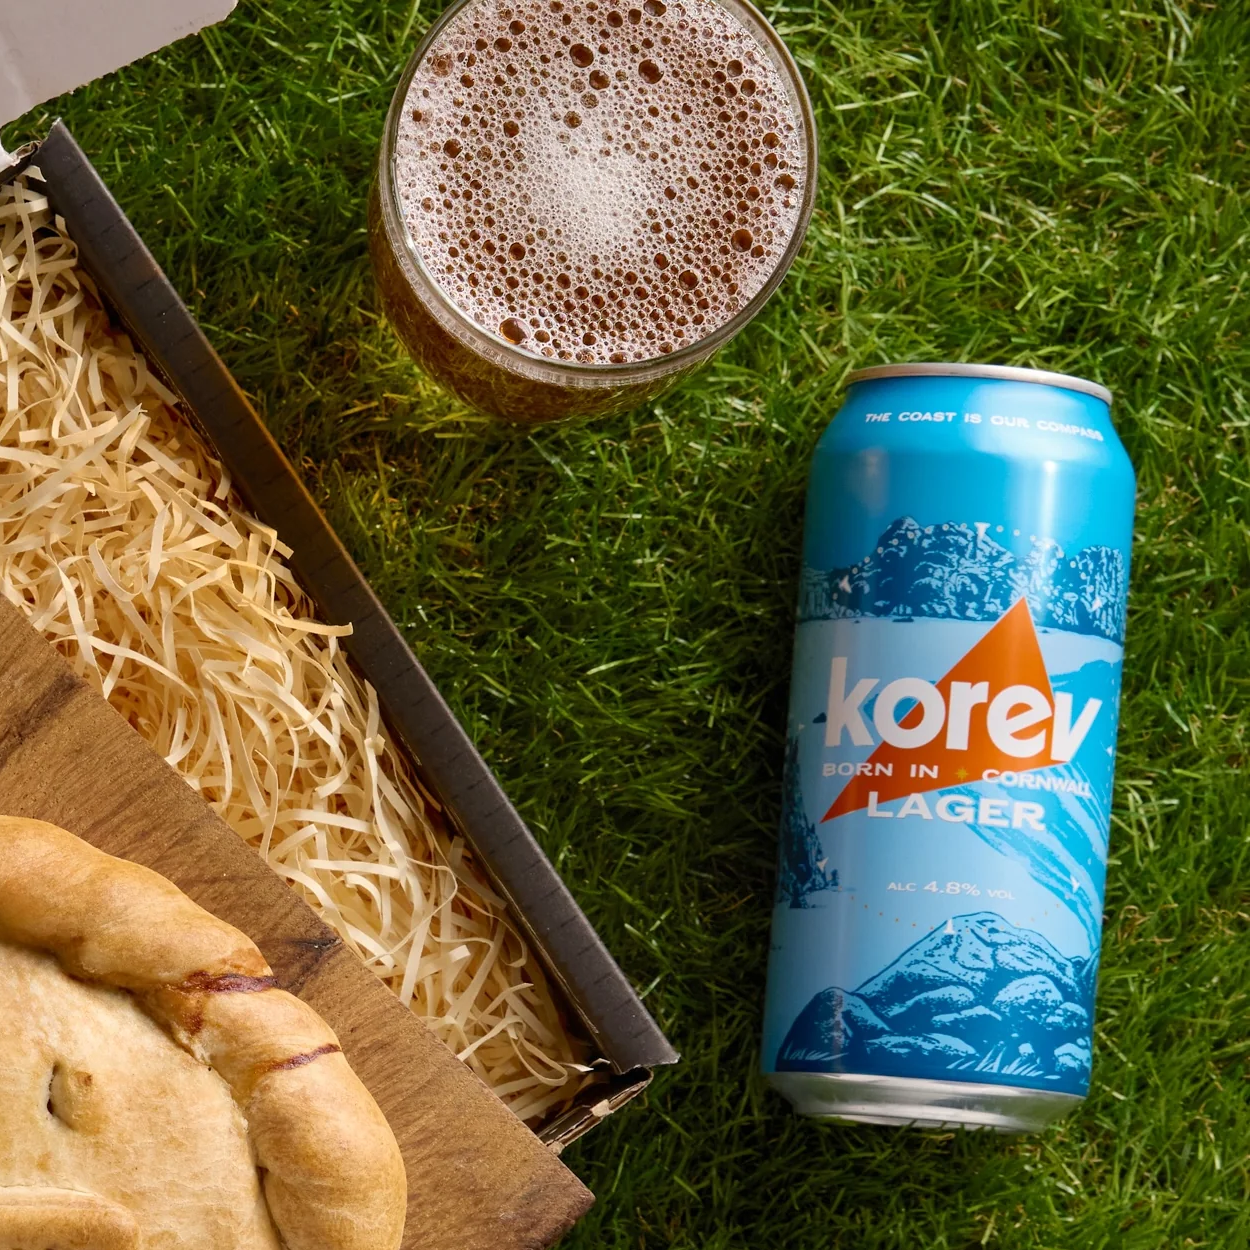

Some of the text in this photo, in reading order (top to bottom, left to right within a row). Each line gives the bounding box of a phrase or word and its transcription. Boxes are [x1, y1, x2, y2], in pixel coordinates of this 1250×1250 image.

[865, 411, 1104, 442] THE COAST IS OUR COMPASS
[825, 657, 1103, 762] korev
[822, 761, 1092, 798] BORN IN CORNWALL
[867, 791, 1046, 831] LAGER
[887, 880, 1016, 900] ALC 4.8% VOL
